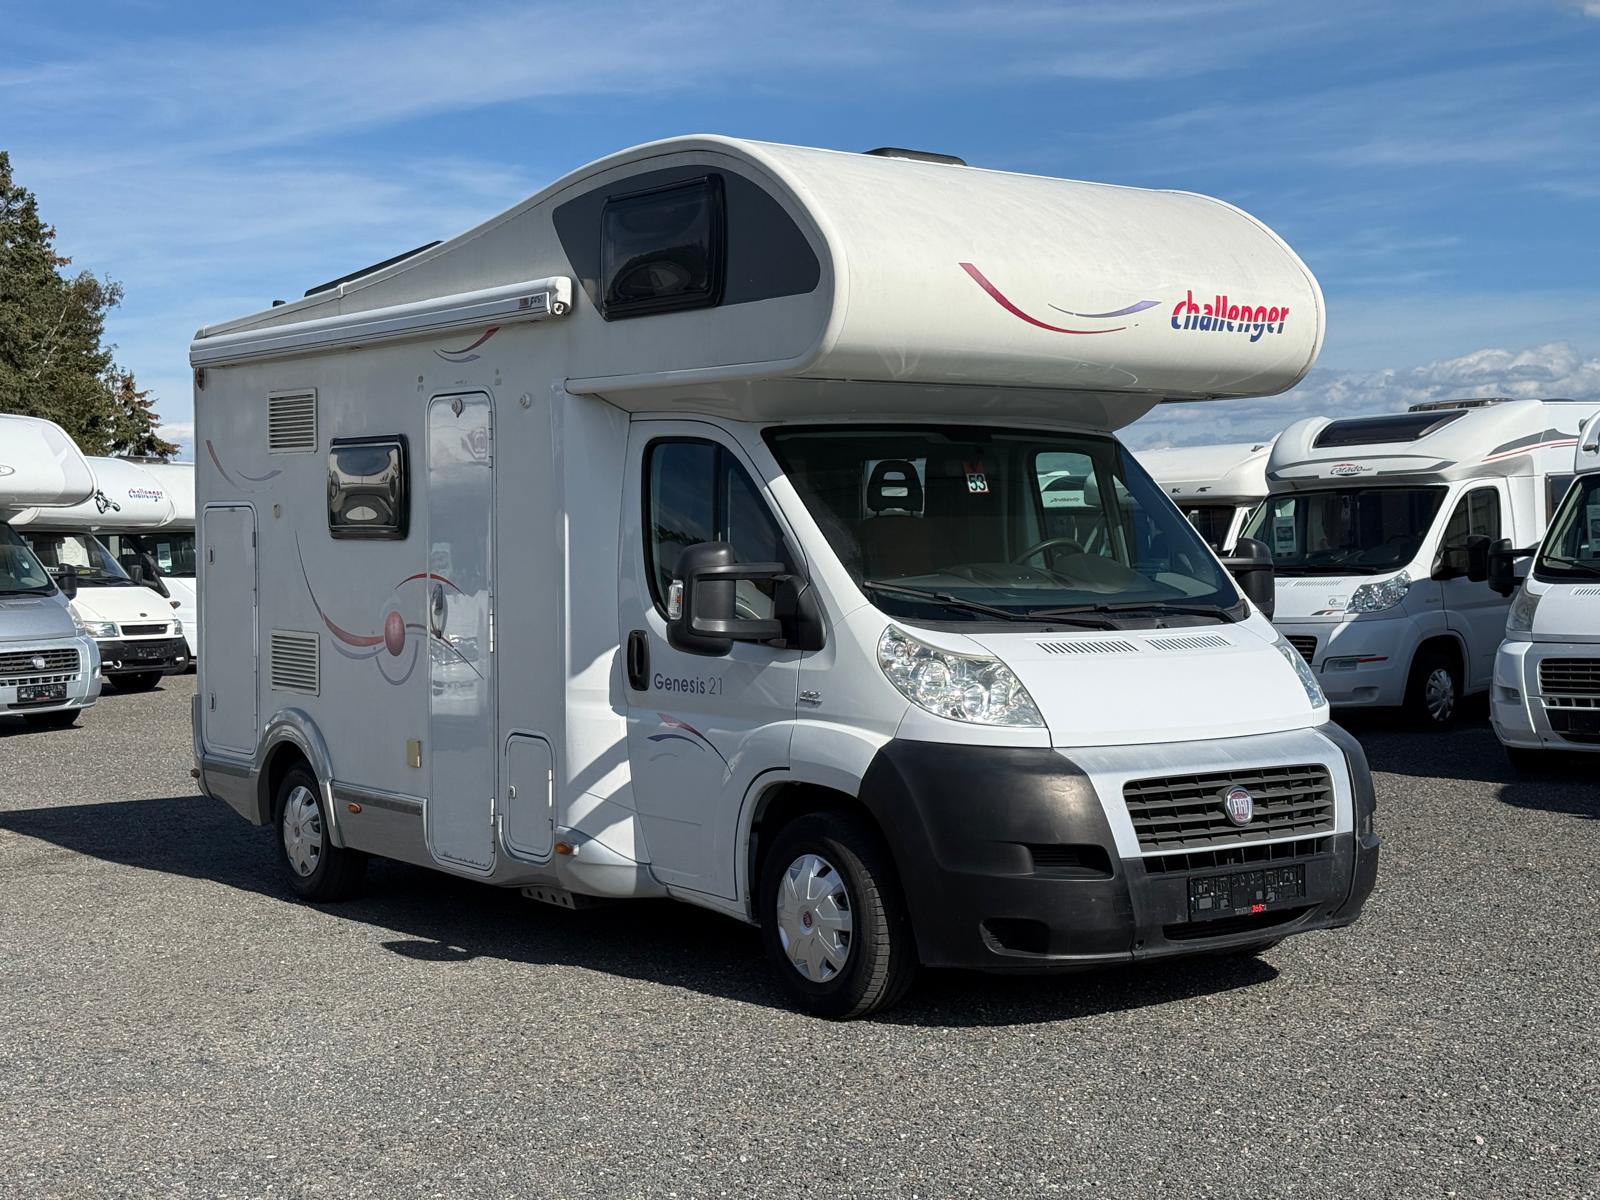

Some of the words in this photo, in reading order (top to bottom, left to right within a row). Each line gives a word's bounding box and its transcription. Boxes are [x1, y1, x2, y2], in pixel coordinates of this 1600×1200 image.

[968, 474, 987, 491] 53
[653, 672, 706, 695] Genesis
[708, 677, 723, 695] 21
